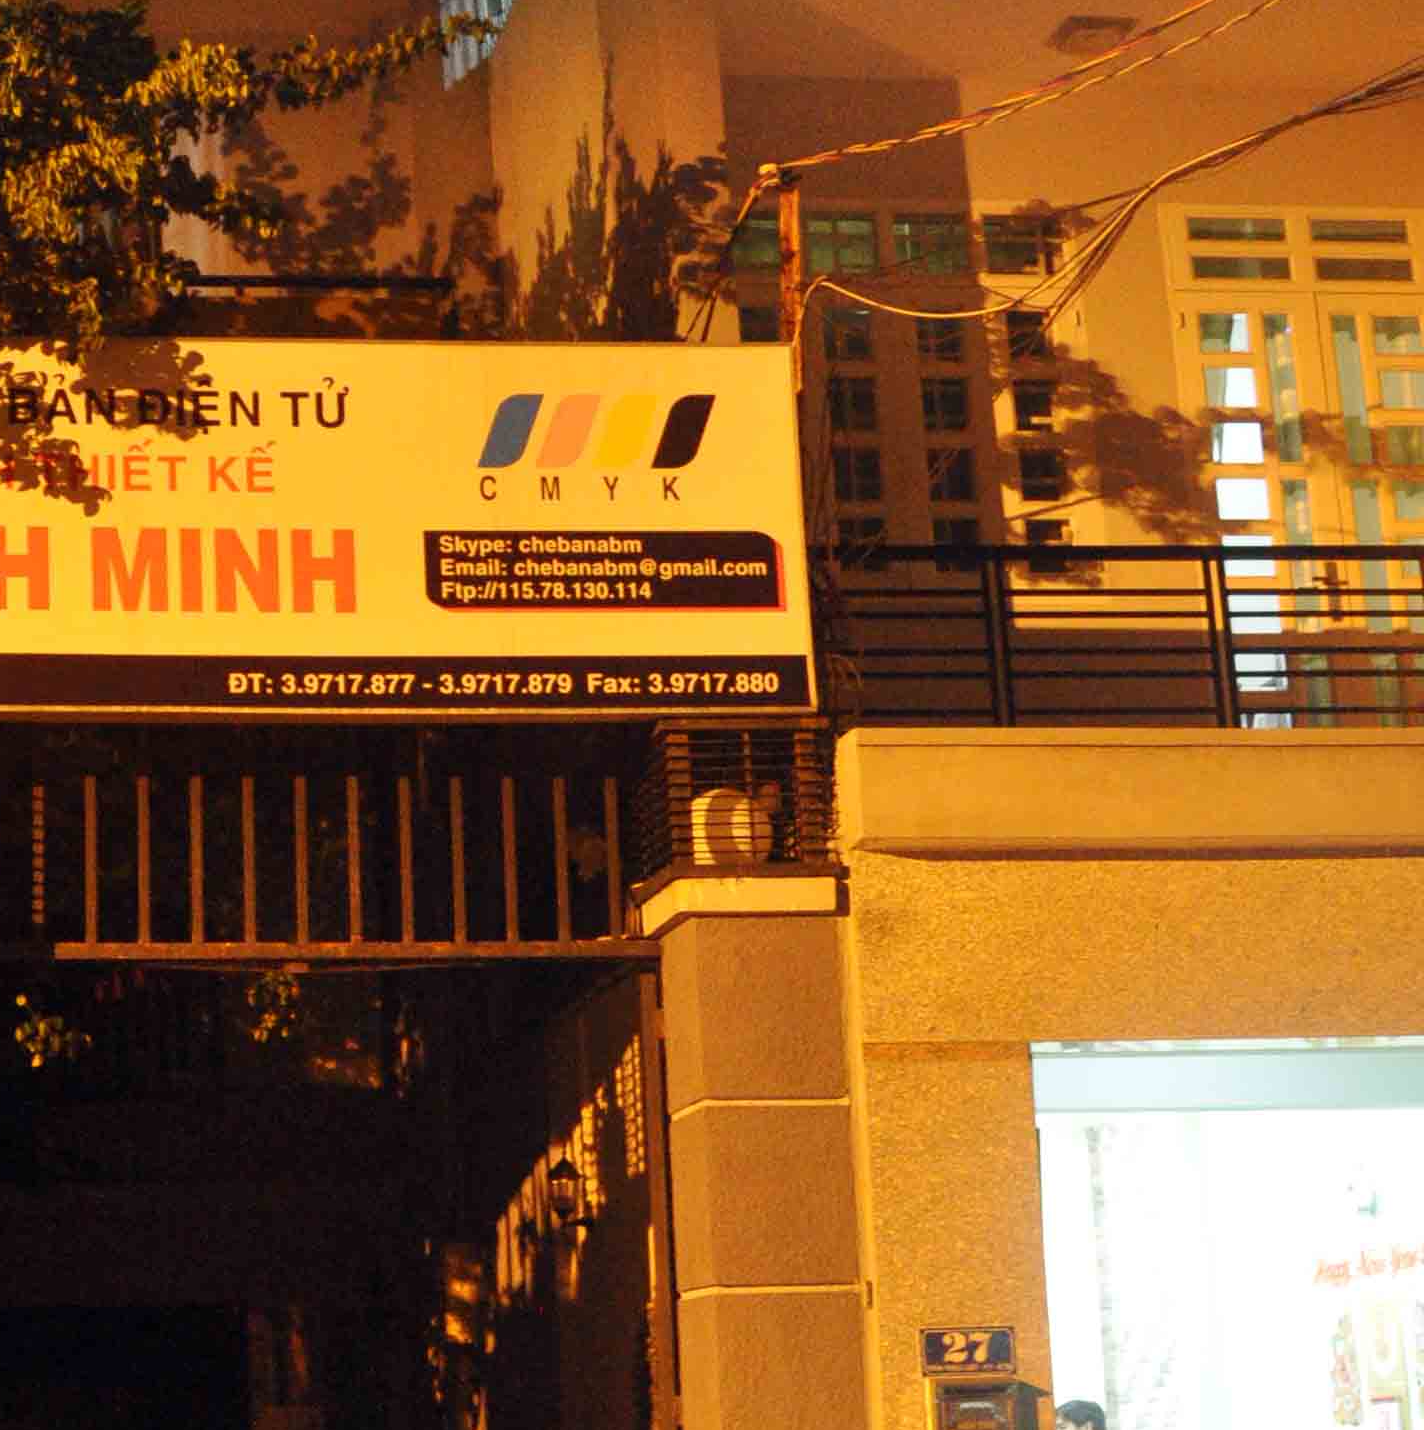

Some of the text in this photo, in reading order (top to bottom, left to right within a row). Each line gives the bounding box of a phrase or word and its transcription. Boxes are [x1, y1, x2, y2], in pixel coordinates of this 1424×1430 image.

[280, 377, 350, 429] TỬ
[208, 441, 275, 494] KẾ
[479, 475, 680, 501] C M Y K
[439, 536, 642, 558] Skype: chebanabm
[89, 526, 358, 614] MINH
[440, 559, 767, 580] Email: chebanabm@gmail.com
[441, 582, 652, 602] Ftp://115.78.130.114
[229, 673, 273, 693] ĐT:
[281, 674, 415, 694] 3.9717.877
[440, 674, 572, 694] 3.9717.879
[587, 674, 640, 694] Fax:
[648, 674, 779, 694] 3.9717.880
[942, 1332, 992, 1363] 27
